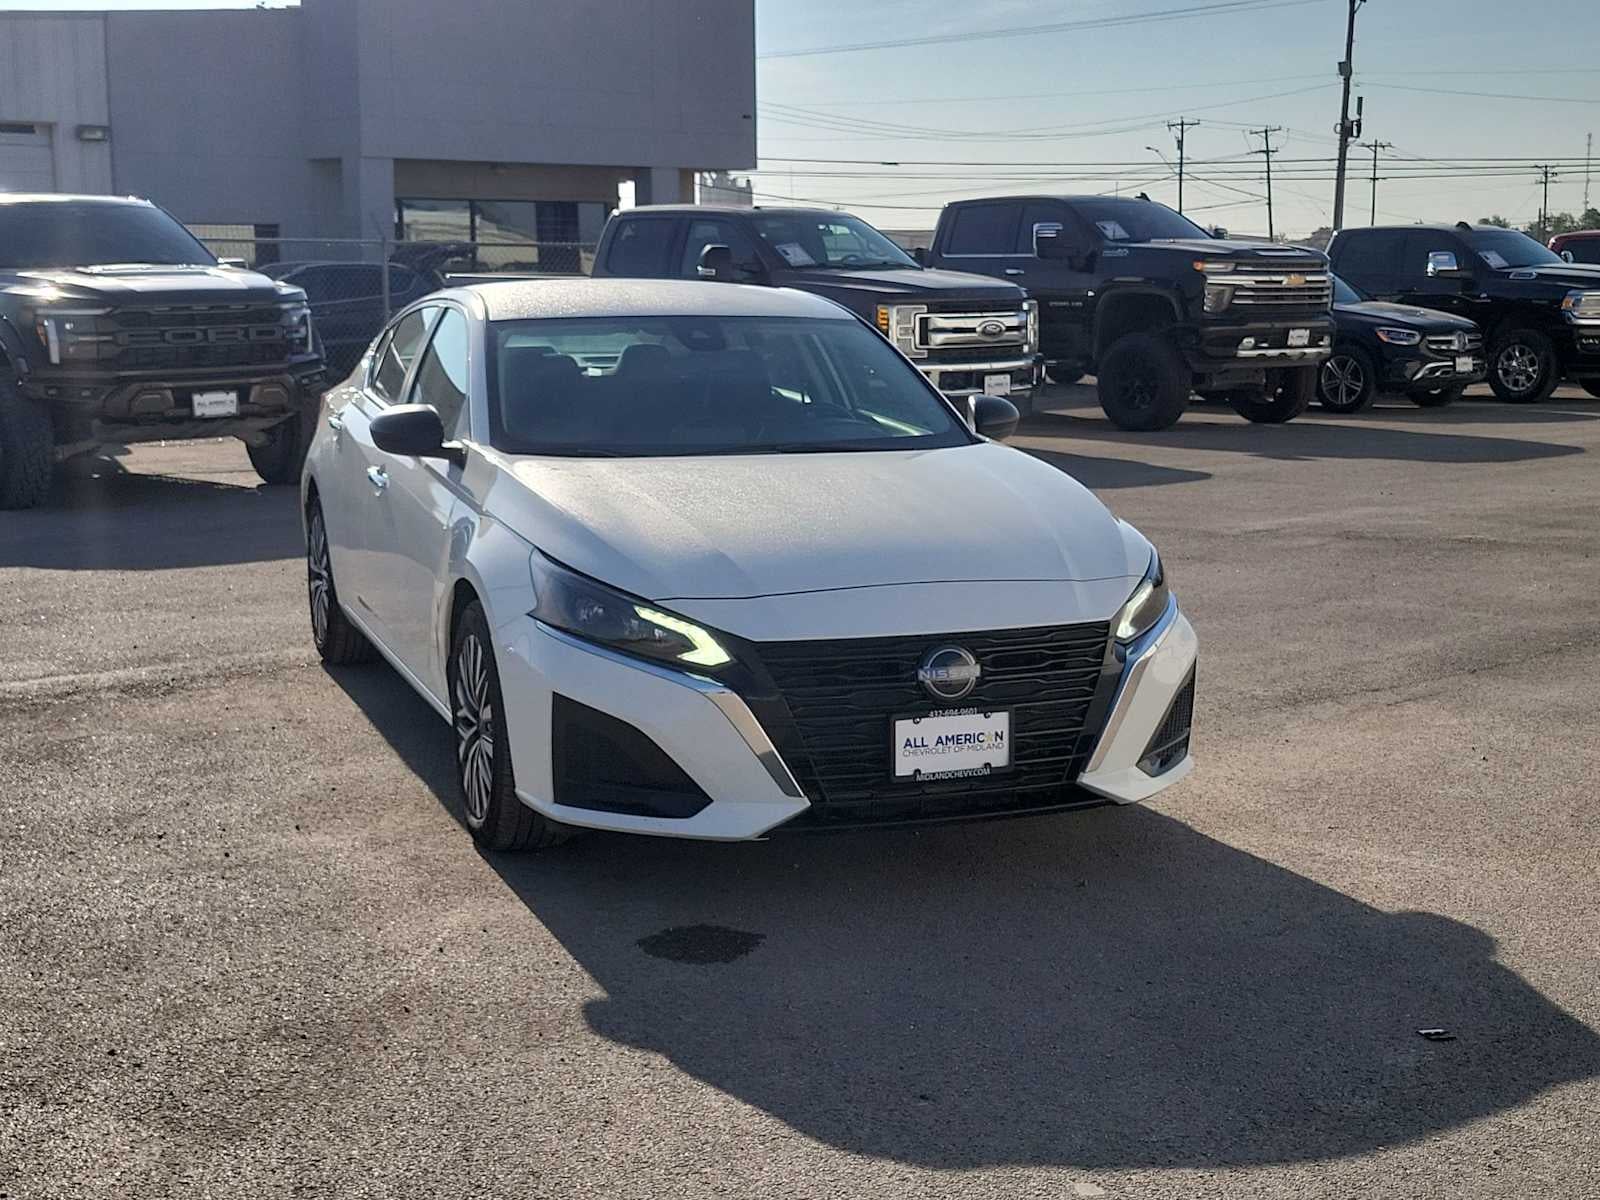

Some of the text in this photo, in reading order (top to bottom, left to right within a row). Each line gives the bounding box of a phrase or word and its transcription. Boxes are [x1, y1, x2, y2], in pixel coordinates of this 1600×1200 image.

[114, 325, 284, 347] FORD
[902, 742, 1005, 757] CHEVROLET OF MIDLAND
[903, 736, 928, 749] ALL
